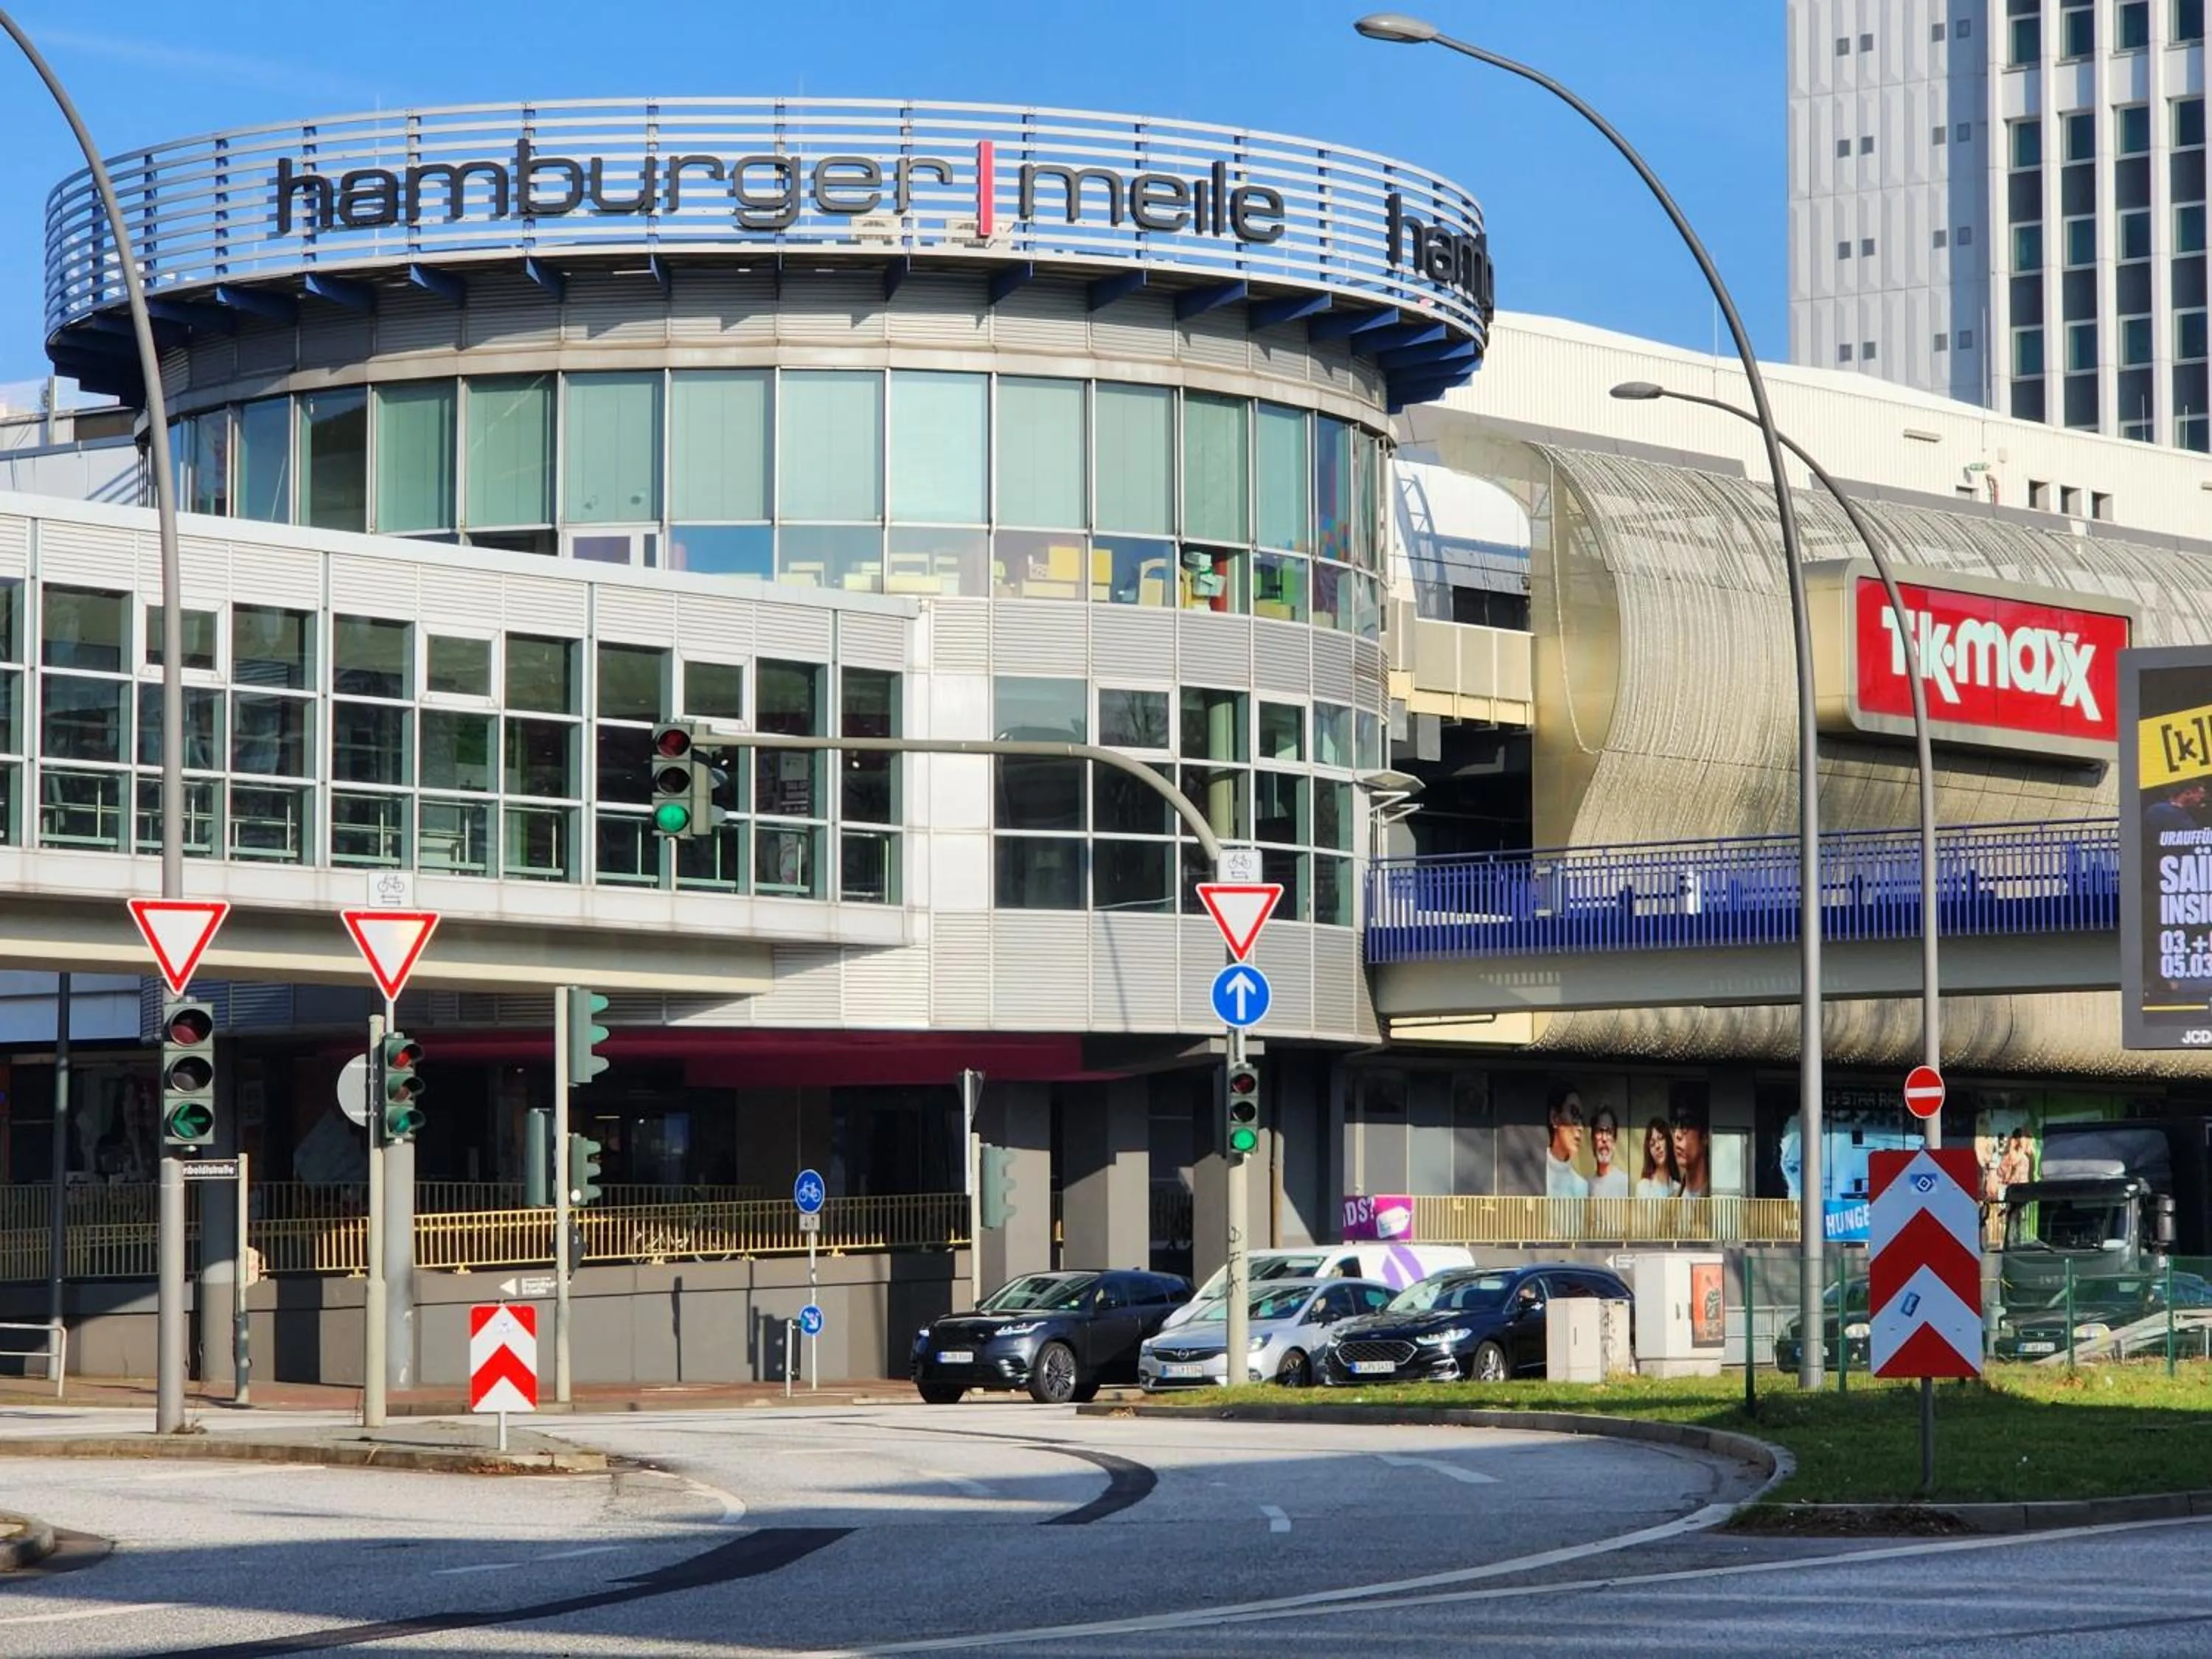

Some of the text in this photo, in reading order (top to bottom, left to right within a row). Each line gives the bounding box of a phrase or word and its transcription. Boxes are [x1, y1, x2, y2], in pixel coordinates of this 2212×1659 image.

[277, 138, 1284, 243] hamburger meile
[2160, 846, 2212, 894] SAÏ
[2160, 893, 2212, 925] INSI
